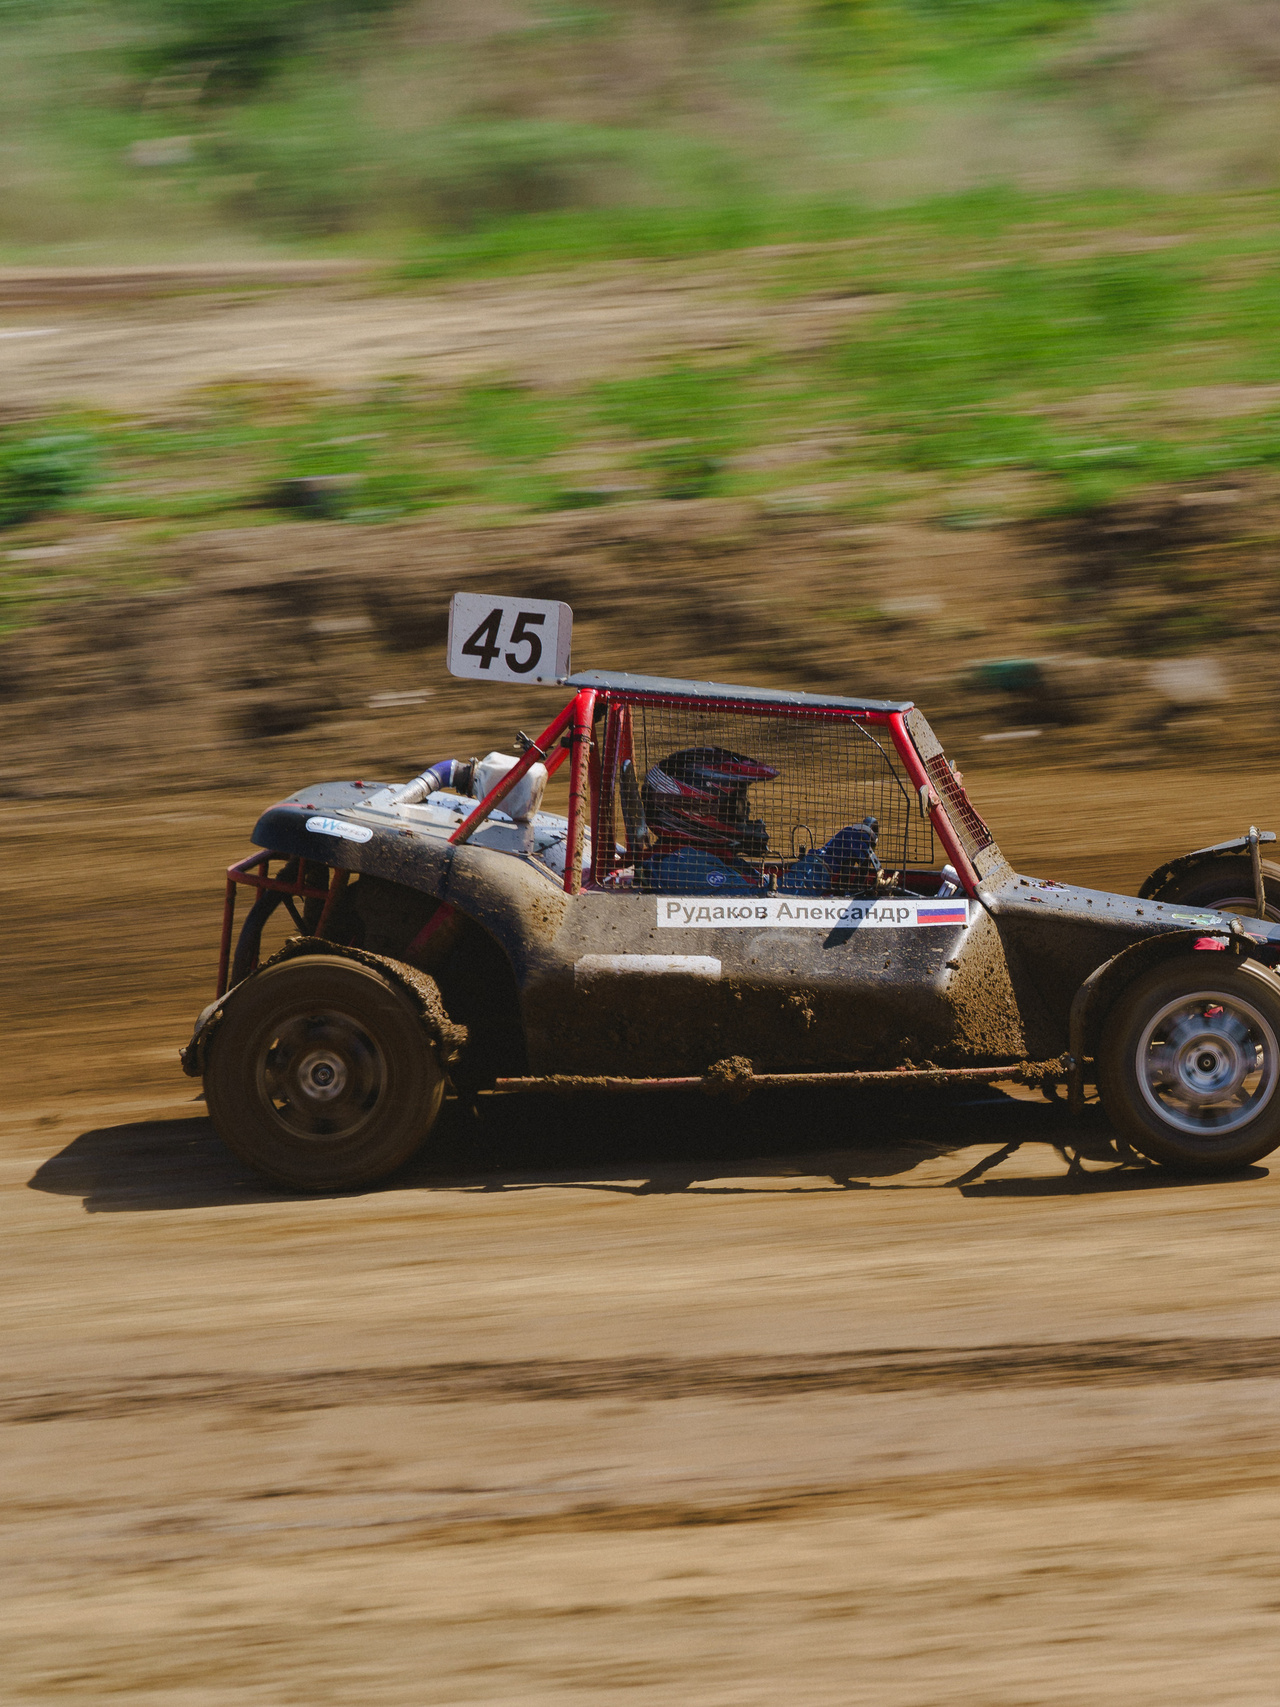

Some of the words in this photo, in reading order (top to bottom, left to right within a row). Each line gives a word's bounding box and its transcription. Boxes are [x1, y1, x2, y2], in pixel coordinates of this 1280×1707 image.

[461, 608, 546, 674] 45
[666, 901, 768, 924] Рудаков
[776, 902, 910, 923] Александр
